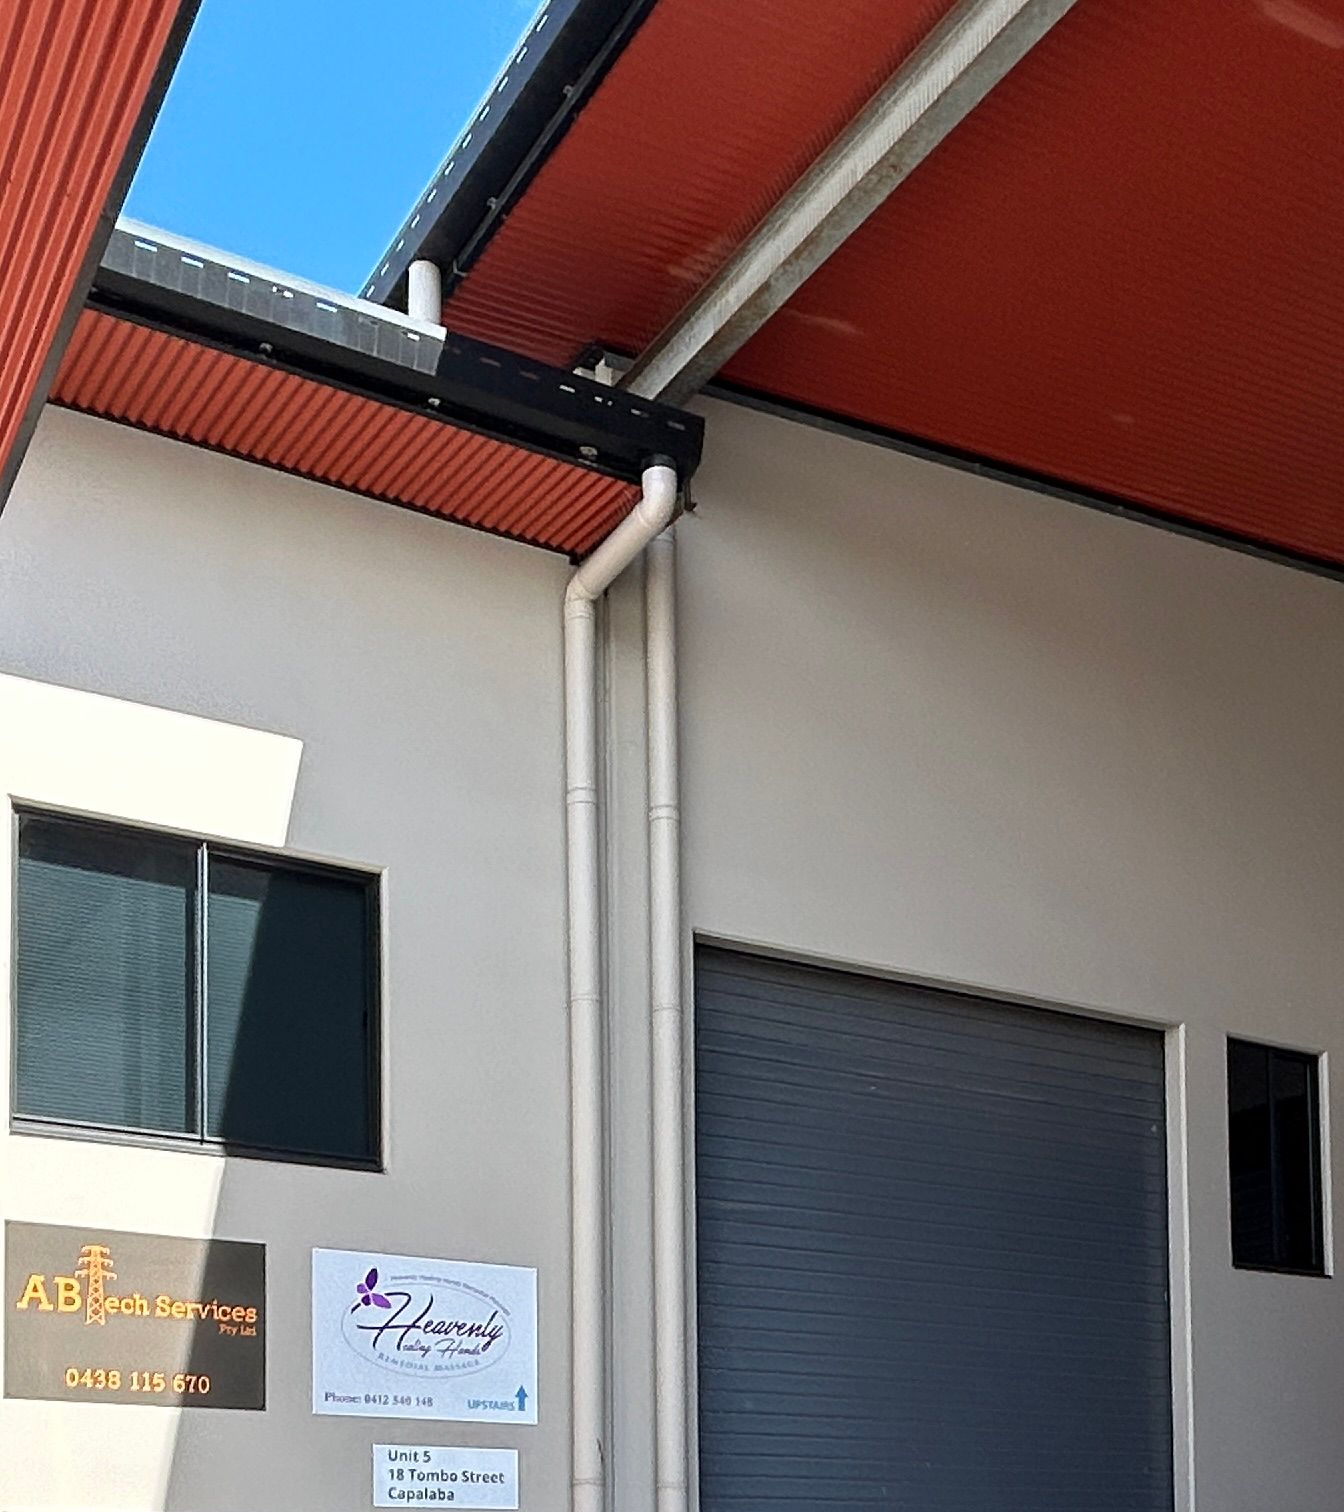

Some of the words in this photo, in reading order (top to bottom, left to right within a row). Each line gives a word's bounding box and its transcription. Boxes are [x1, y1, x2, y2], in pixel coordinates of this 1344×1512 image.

[156, 1294, 258, 1324] Services
[351, 1291, 504, 1352] Heavenly
[64, 1367, 122, 1390] 0438
[129, 1370, 166, 1393] 115
[172, 1374, 211, 1395] 670
[467, 1399, 515, 1412] UPSTAIRS
[388, 1450, 419, 1462] Unit
[423, 1450, 432, 1463] 5
[389, 1468, 405, 1481] 18
[408, 1468, 458, 1482] Tombo
[461, 1470, 505, 1484] Street
[388, 1487, 455, 1502] Capalaba
